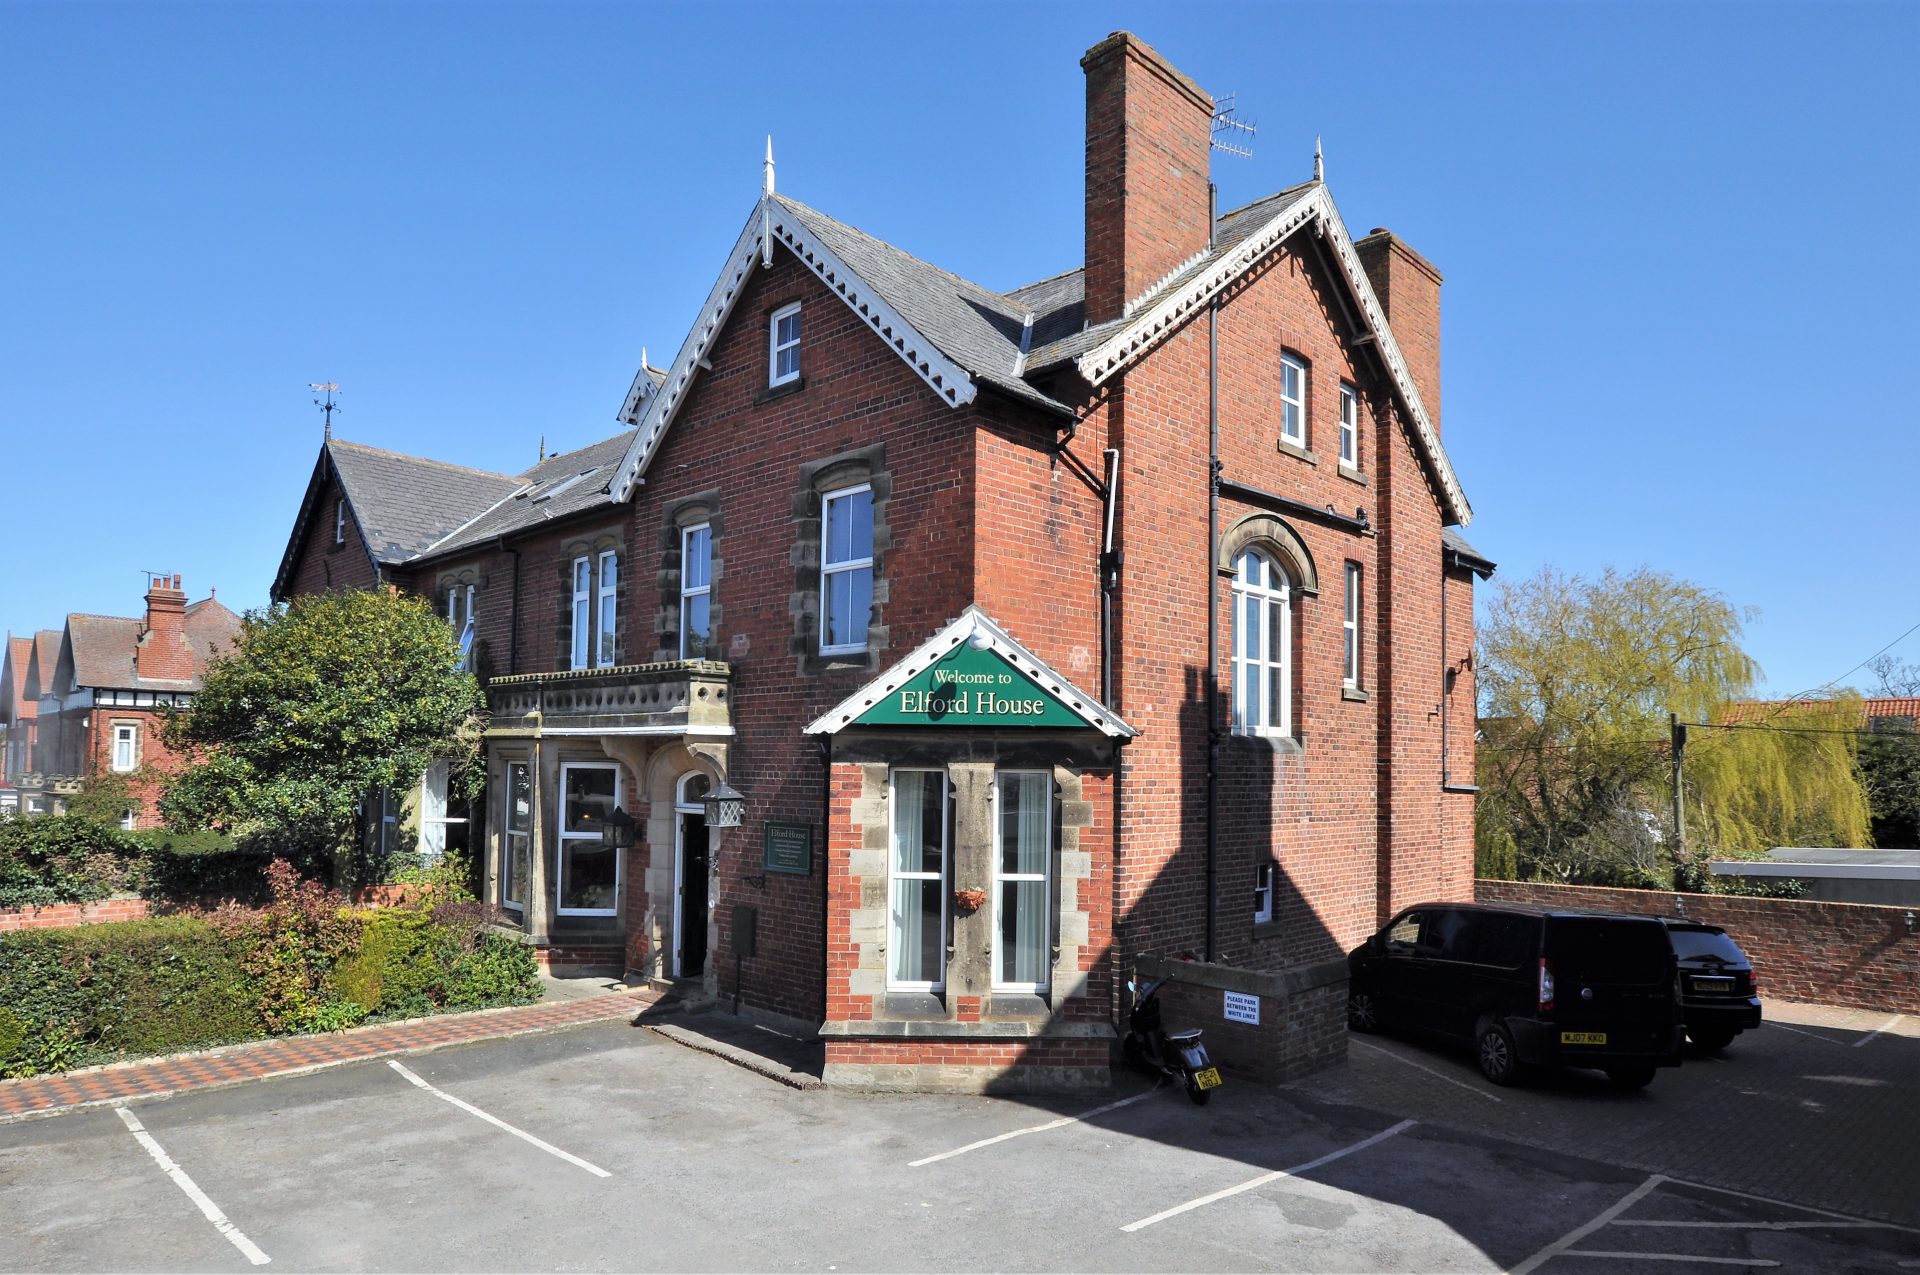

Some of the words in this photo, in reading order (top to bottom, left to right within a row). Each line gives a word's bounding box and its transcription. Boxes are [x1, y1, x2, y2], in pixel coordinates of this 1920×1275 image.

[934, 669, 994, 685] Welcome
[998, 673, 1012, 685] to
[899, 690, 969, 714] Elford
[976, 691, 1045, 716] House
[789, 829, 806, 840] House
[1226, 995, 1243, 1003] PLEASE
[1226, 1002, 1247, 1011] BETWEEN
[1227, 1009, 1242, 1017] WHITE
[1243, 1012, 1256, 1020] LINES
